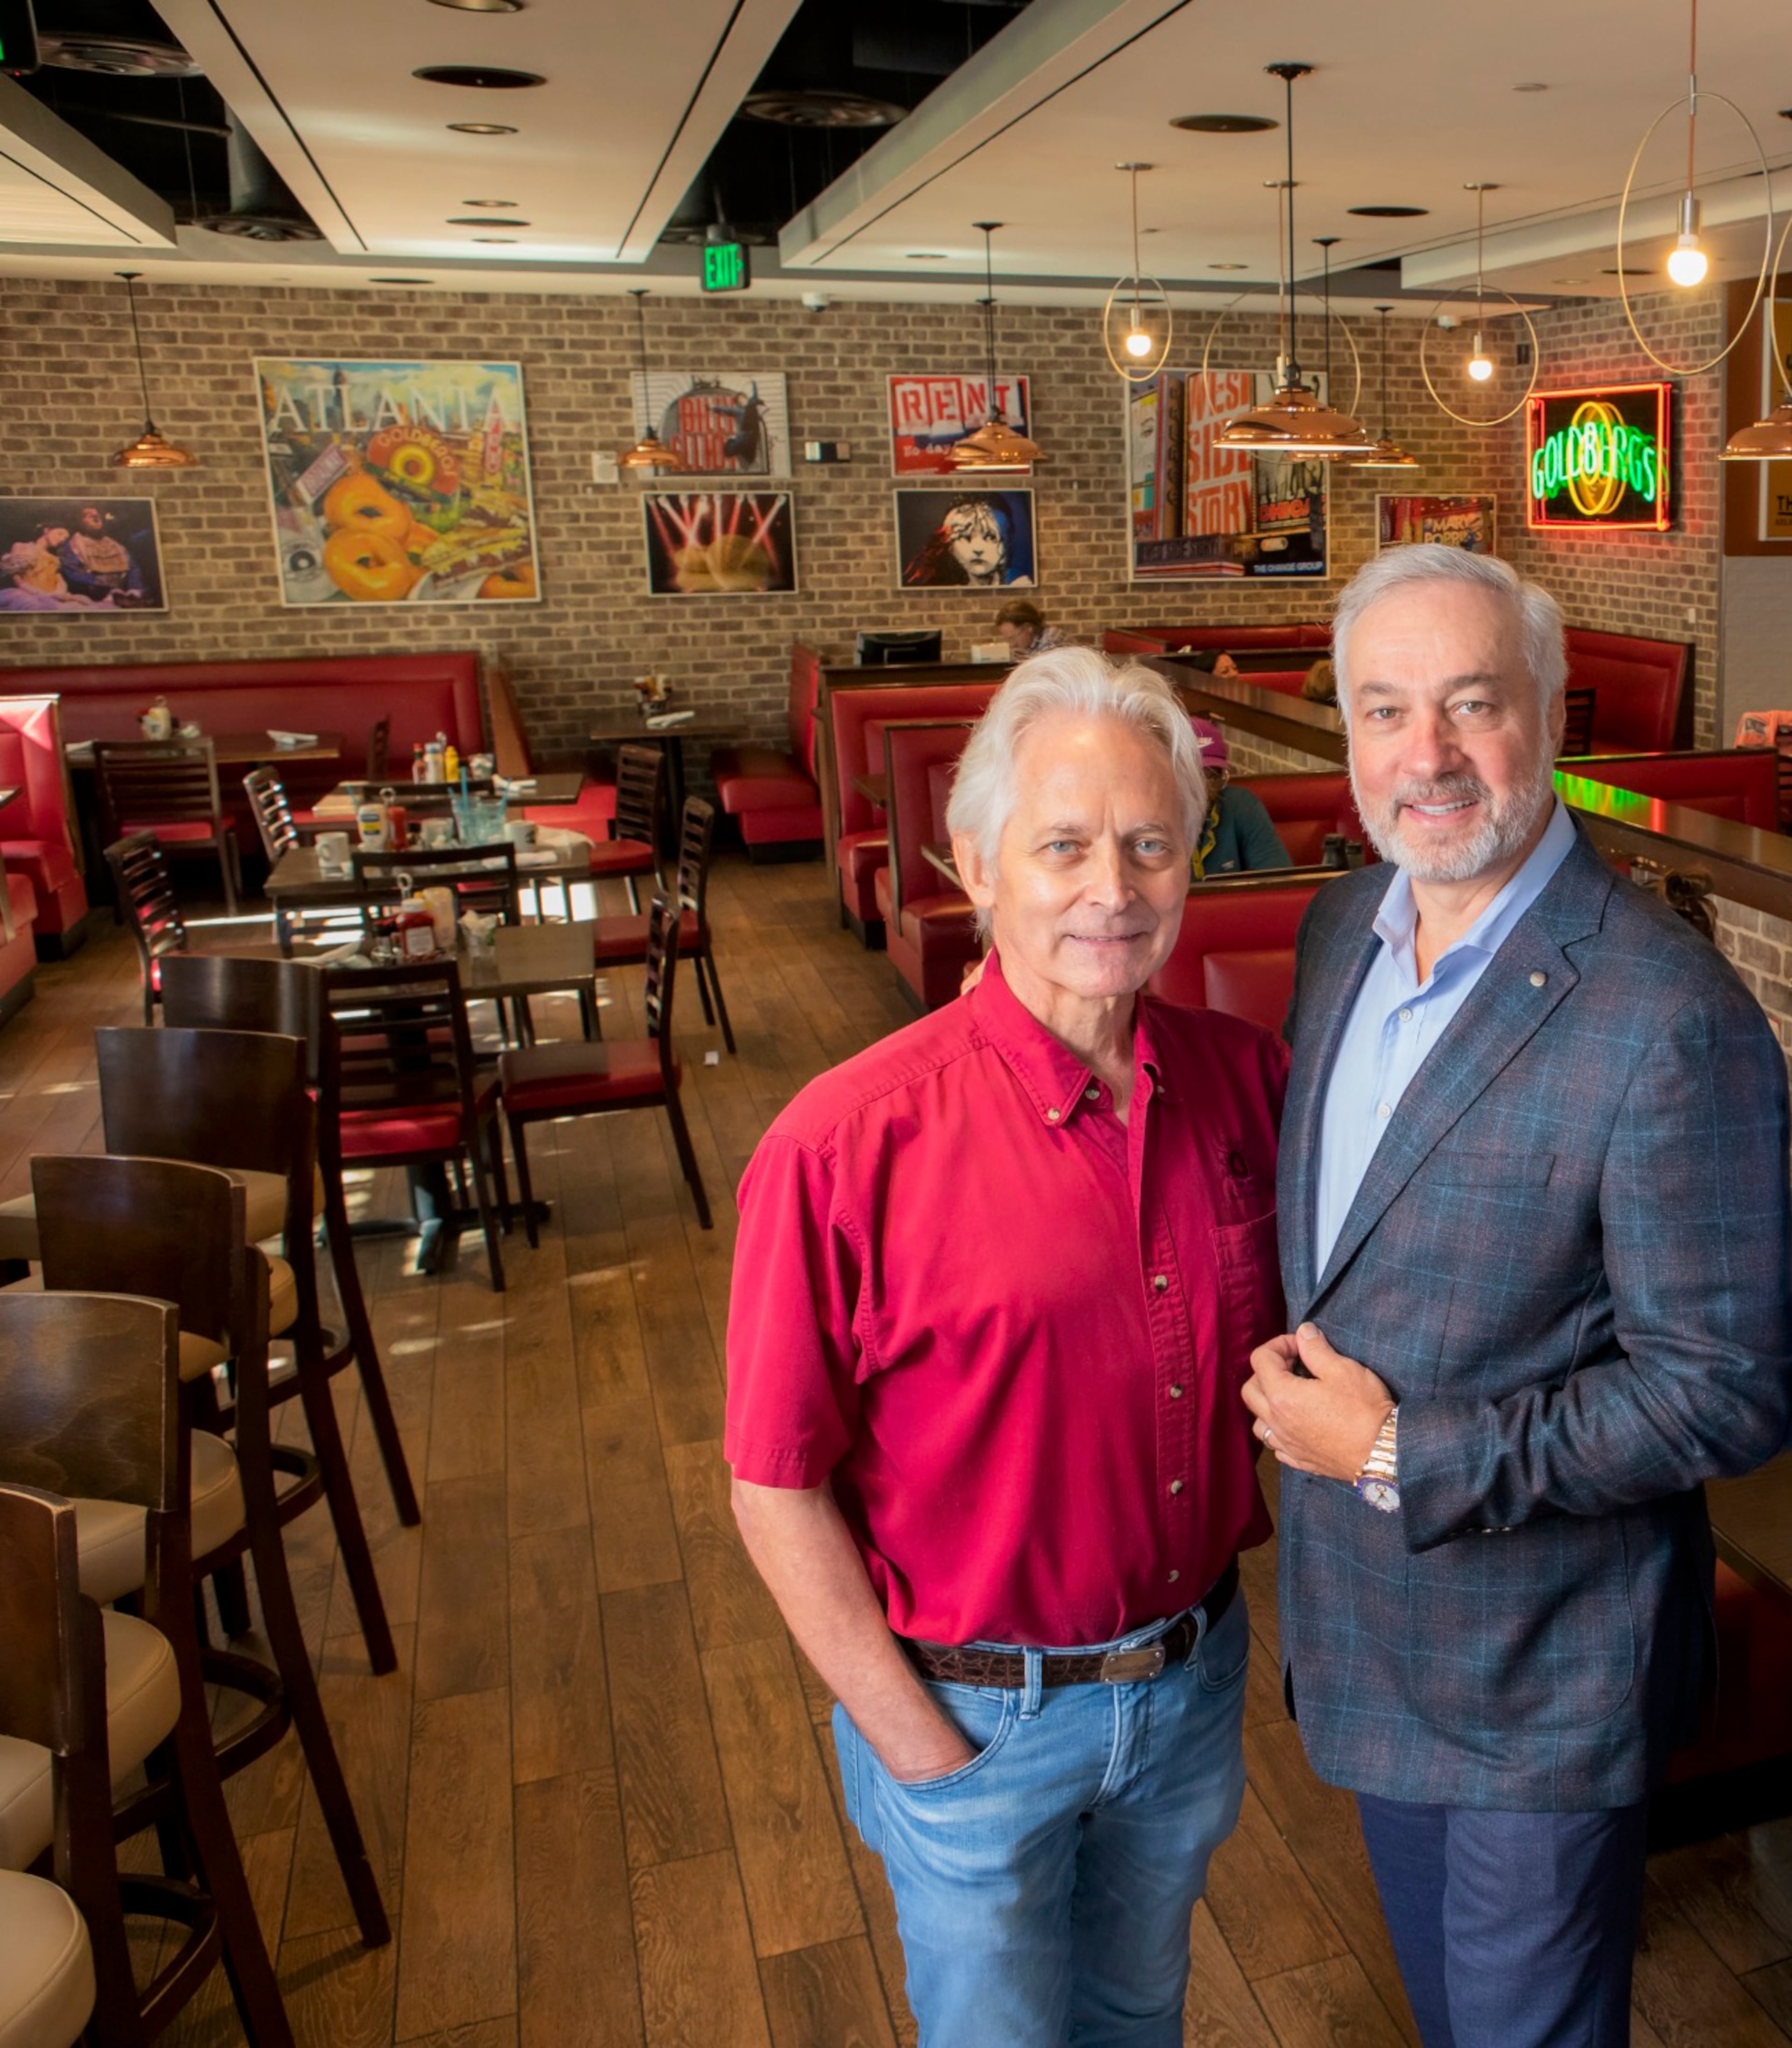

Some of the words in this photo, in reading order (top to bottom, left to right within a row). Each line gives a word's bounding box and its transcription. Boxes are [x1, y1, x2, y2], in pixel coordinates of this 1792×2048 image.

[705, 244, 738, 290] EXIT
[268, 384, 518, 432] ATLANTA
[901, 383, 1010, 422] RENT
[1433, 512, 1479, 533] MARY
[1253, 565, 1266, 573] THE
